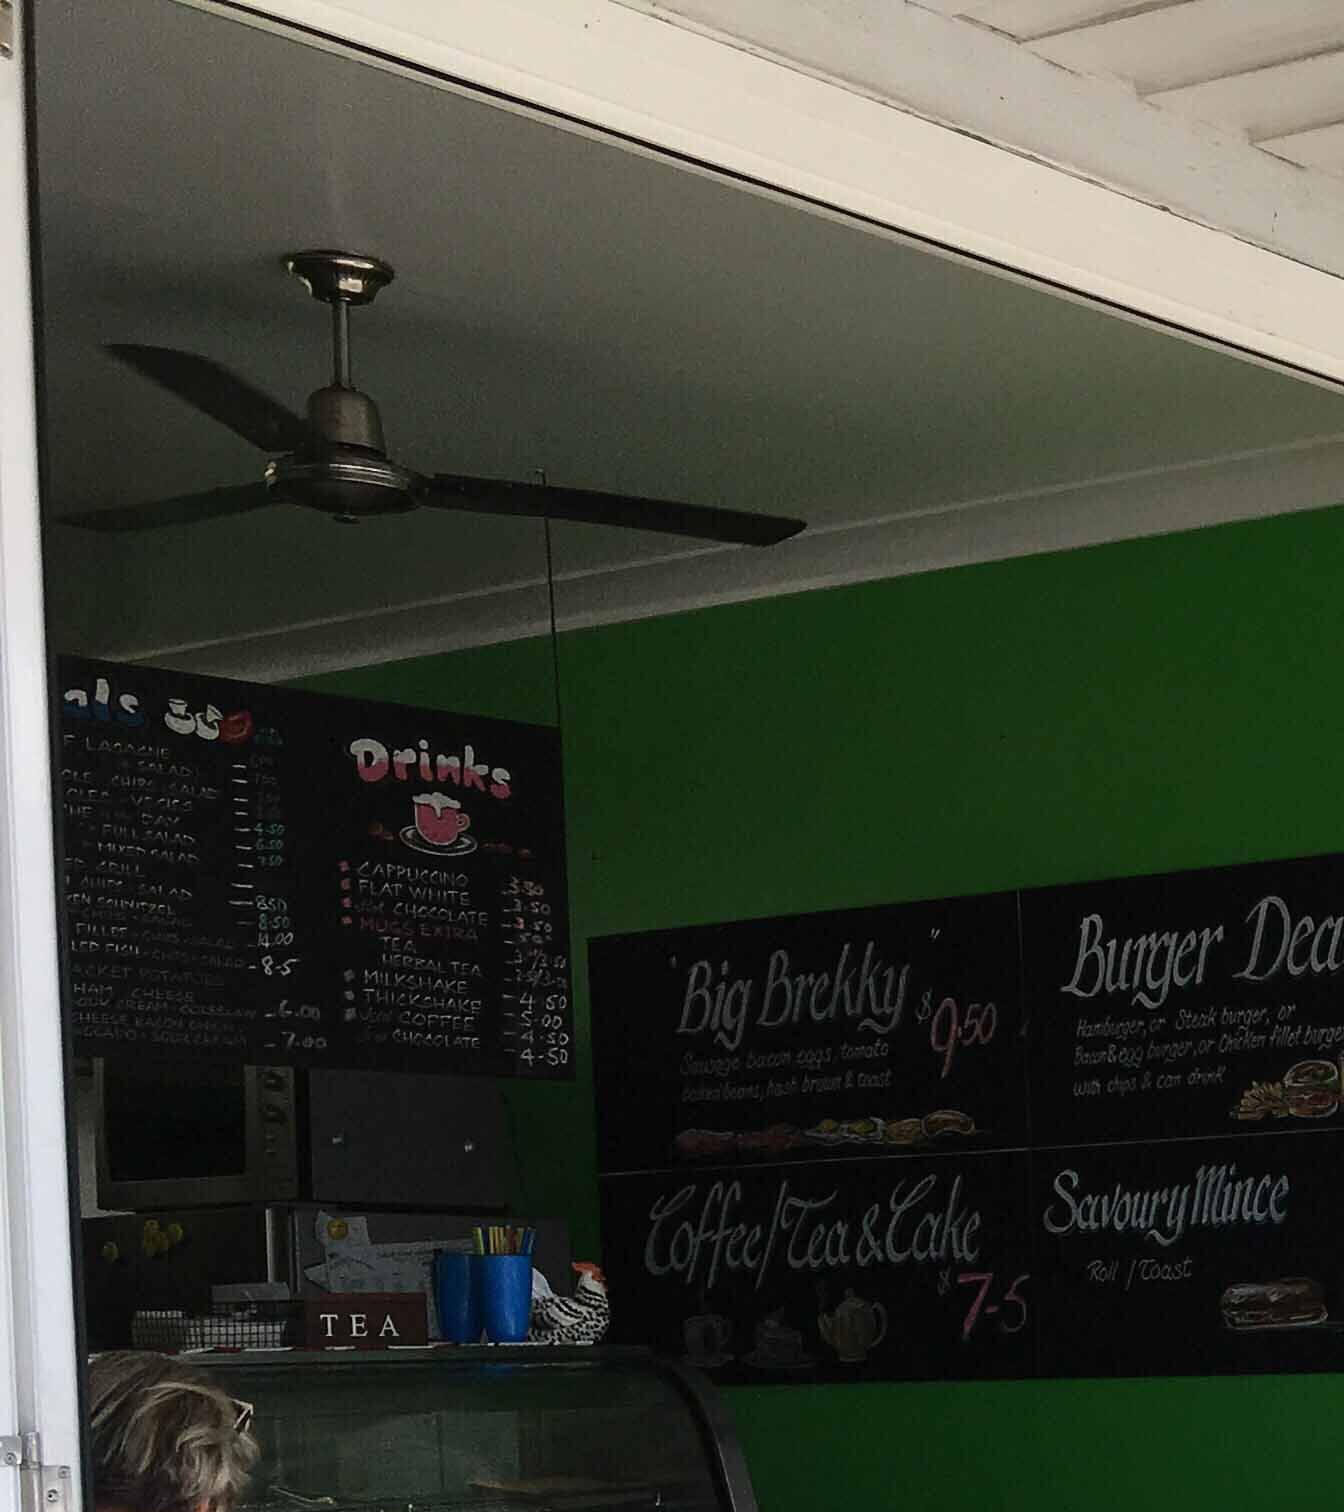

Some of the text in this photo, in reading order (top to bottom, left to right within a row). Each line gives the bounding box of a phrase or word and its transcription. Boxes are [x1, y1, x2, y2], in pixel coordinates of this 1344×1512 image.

[350, 737, 513, 801] Drinks
[357, 861, 471, 888] CAPPUCCINO
[357, 879, 473, 908] FLAT WHITE
[391, 900, 490, 929] CHOCOLATE
[380, 935, 418, 955] TEA
[1061, 913, 1225, 1010] Burger
[361, 968, 472, 995] MILKSHAKE
[674, 940, 912, 1051] Big Brekky
[361, 986, 483, 1017] THICKSHAKE
[398, 1009, 477, 1034] COFFEE
[320, 1313, 400, 1337] TEA
